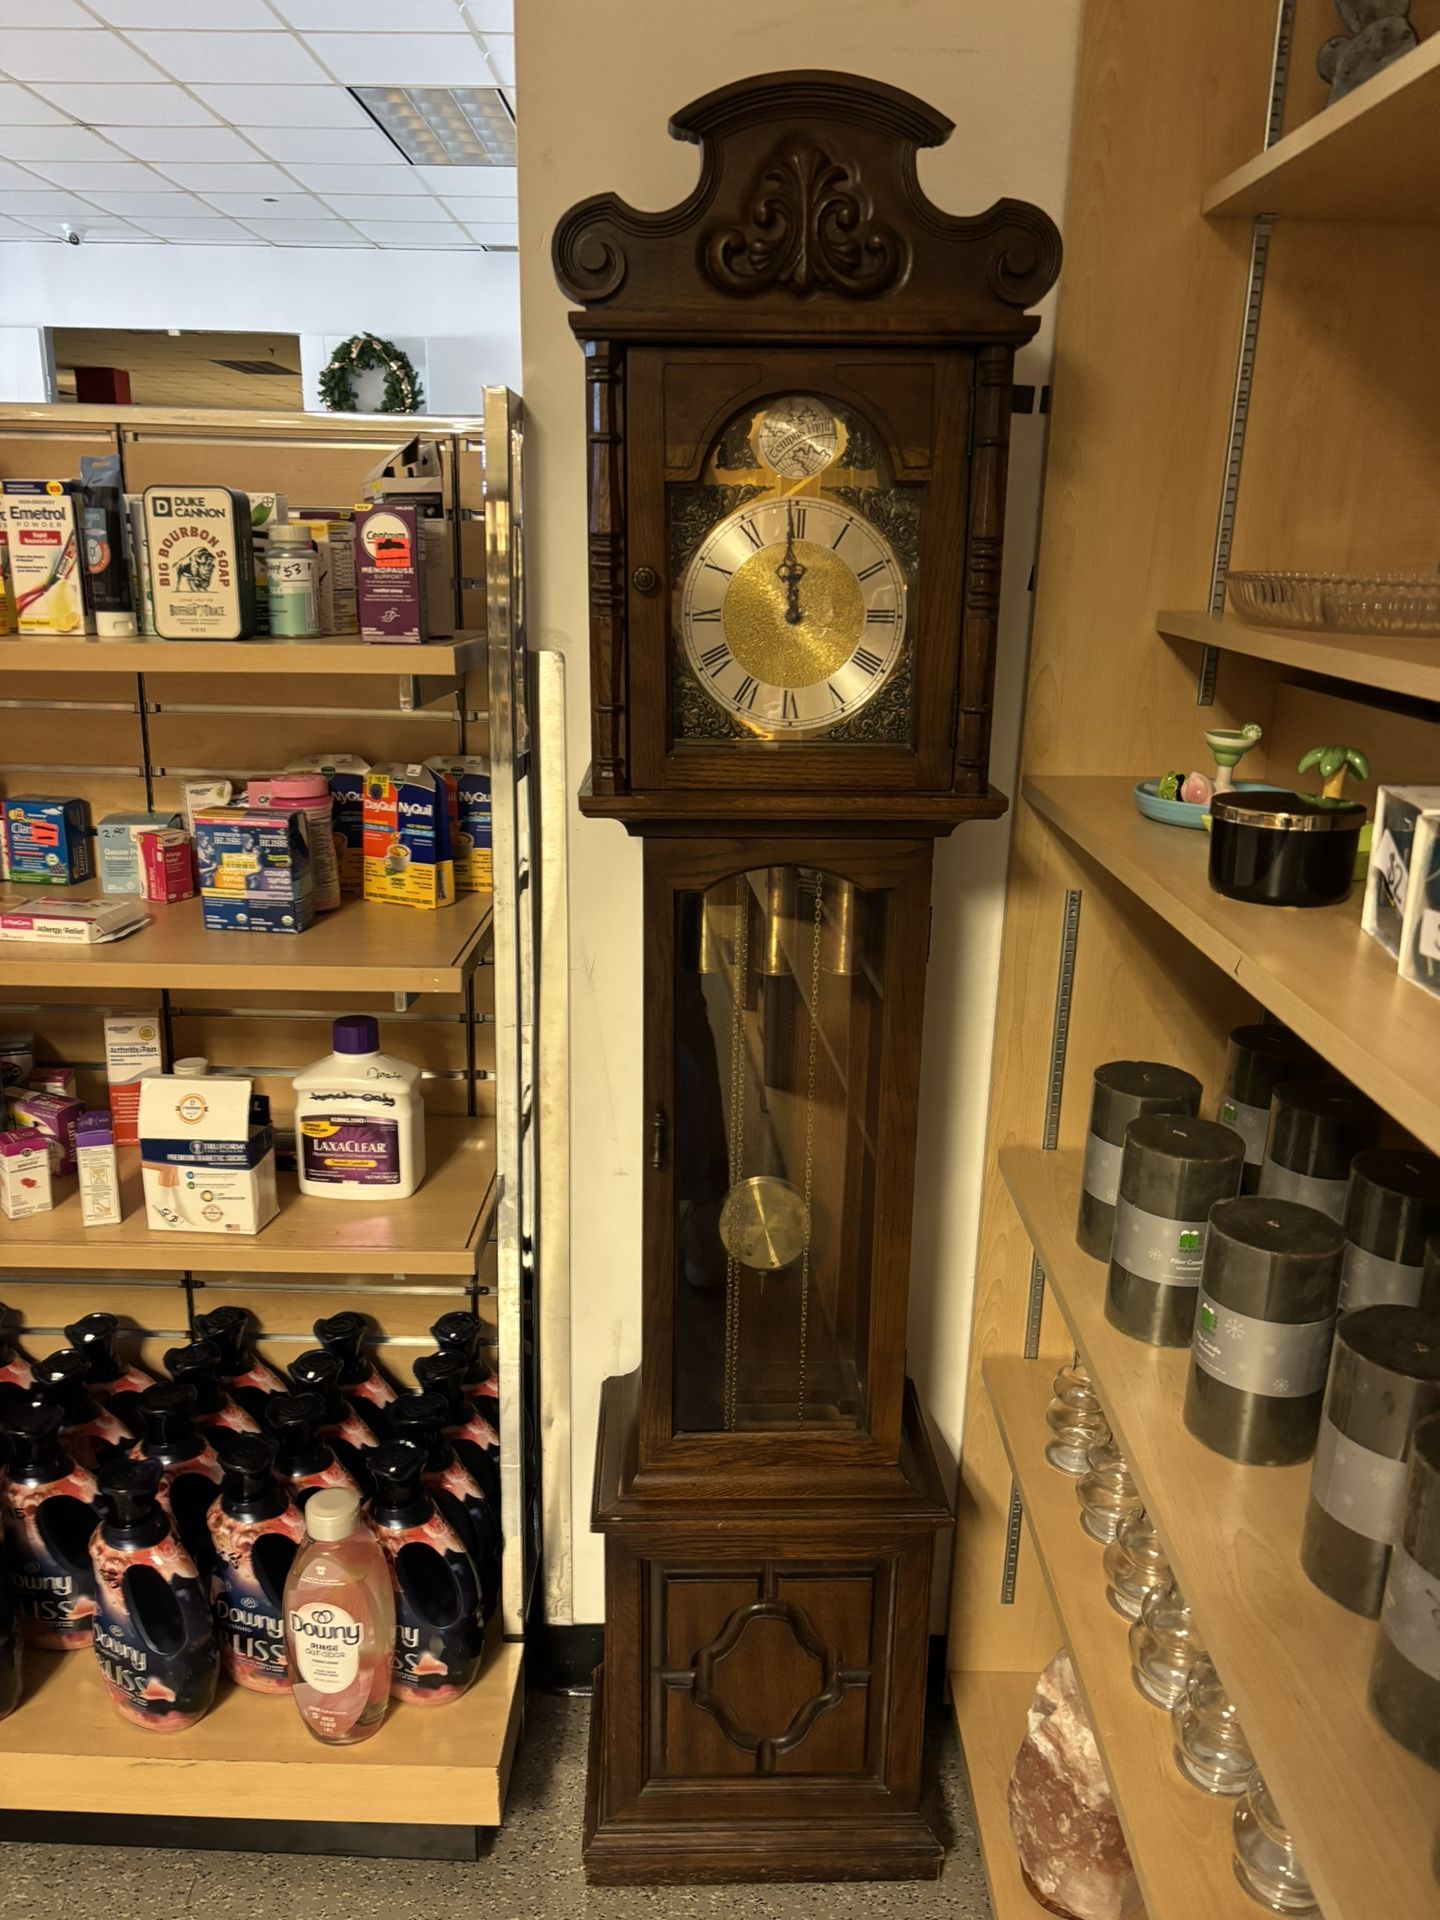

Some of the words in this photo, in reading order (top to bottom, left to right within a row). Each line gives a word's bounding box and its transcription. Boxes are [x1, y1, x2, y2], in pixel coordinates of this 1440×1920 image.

[173, 496, 206, 508] DUKE
[9, 505, 66, 521] Emetrol
[174, 507, 226, 518] CANNON
[16, 521, 62, 529] POWDER
[158, 525, 221, 559] BOURBON
[158, 562, 171, 587] BIG
[215, 549, 230, 588] SOAP
[360, 566, 415, 575] MENOPAUSE
[332, 791, 364, 804] NyQu
[459, 791, 491, 804] NyQu
[364, 799, 397, 813] DayQuil
[398, 801, 434, 817] NyQuil
[259, 839, 289, 848] BLISS
[217, 1600, 284, 1639] Downy
[288, 1613, 360, 1646] Downy
[310, 1642, 339, 1651] RINSE
